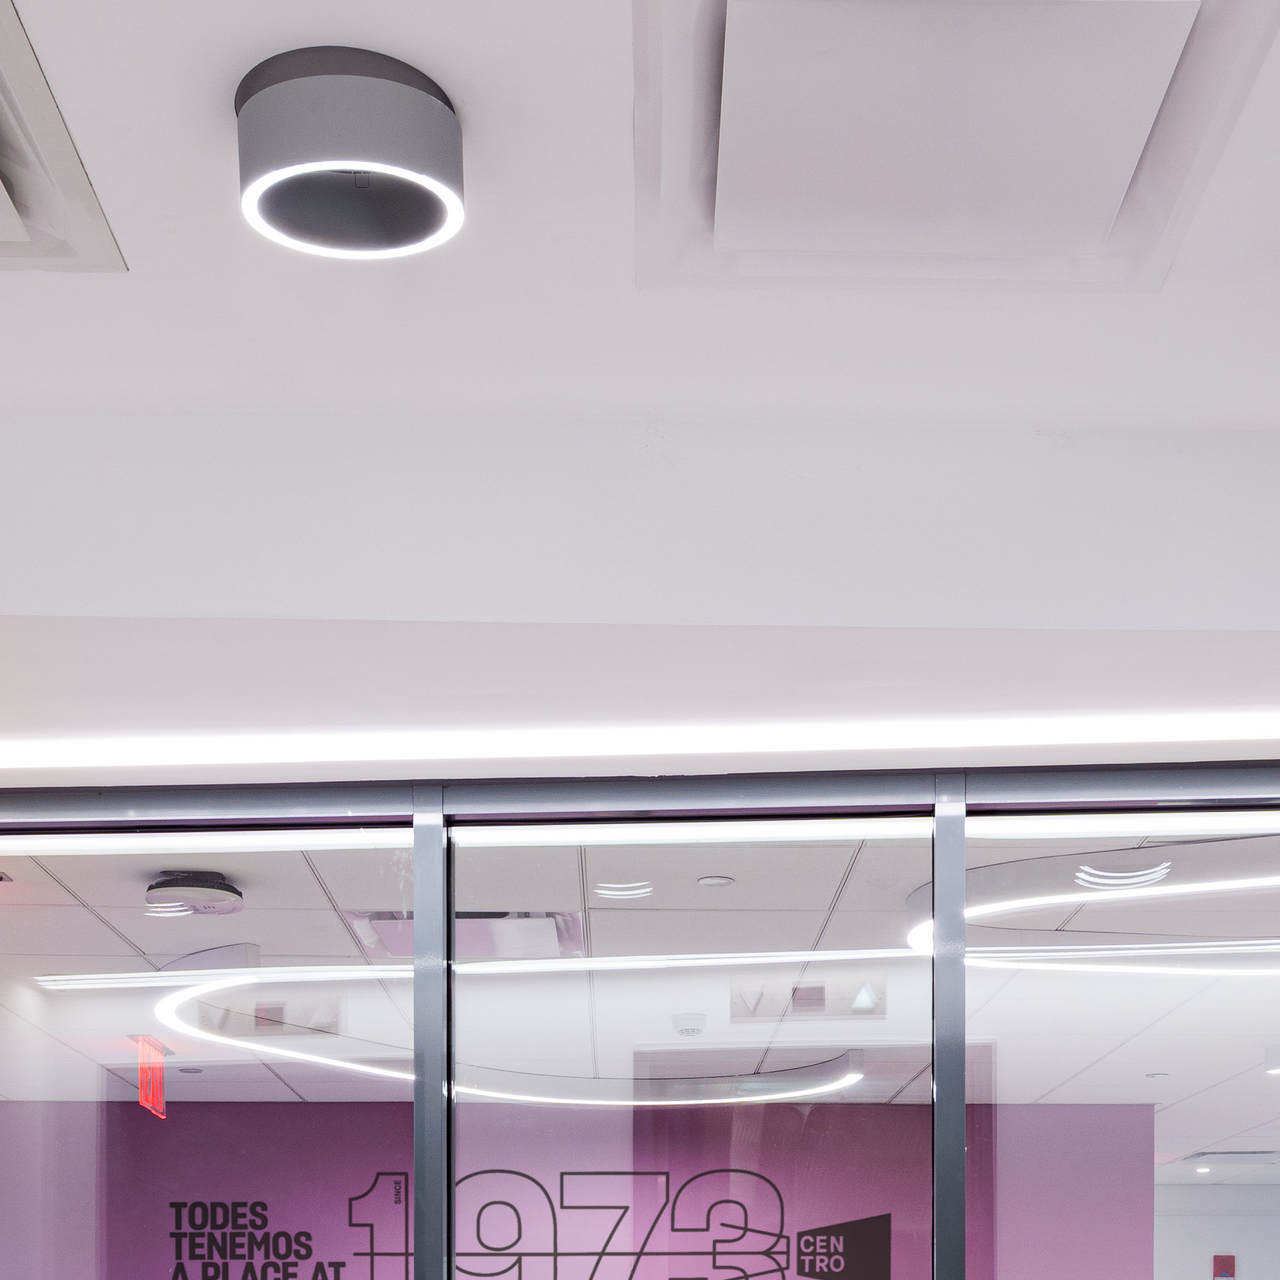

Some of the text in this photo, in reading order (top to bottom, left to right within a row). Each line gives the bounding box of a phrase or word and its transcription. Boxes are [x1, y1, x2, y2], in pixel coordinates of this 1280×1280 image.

[394, 1180, 402, 1205] SINCE
[169, 1201, 268, 1230] TODES
[169, 1231, 313, 1260] TENEMOS
[799, 1235, 844, 1254] CEN
[799, 1255, 845, 1273] TRO
